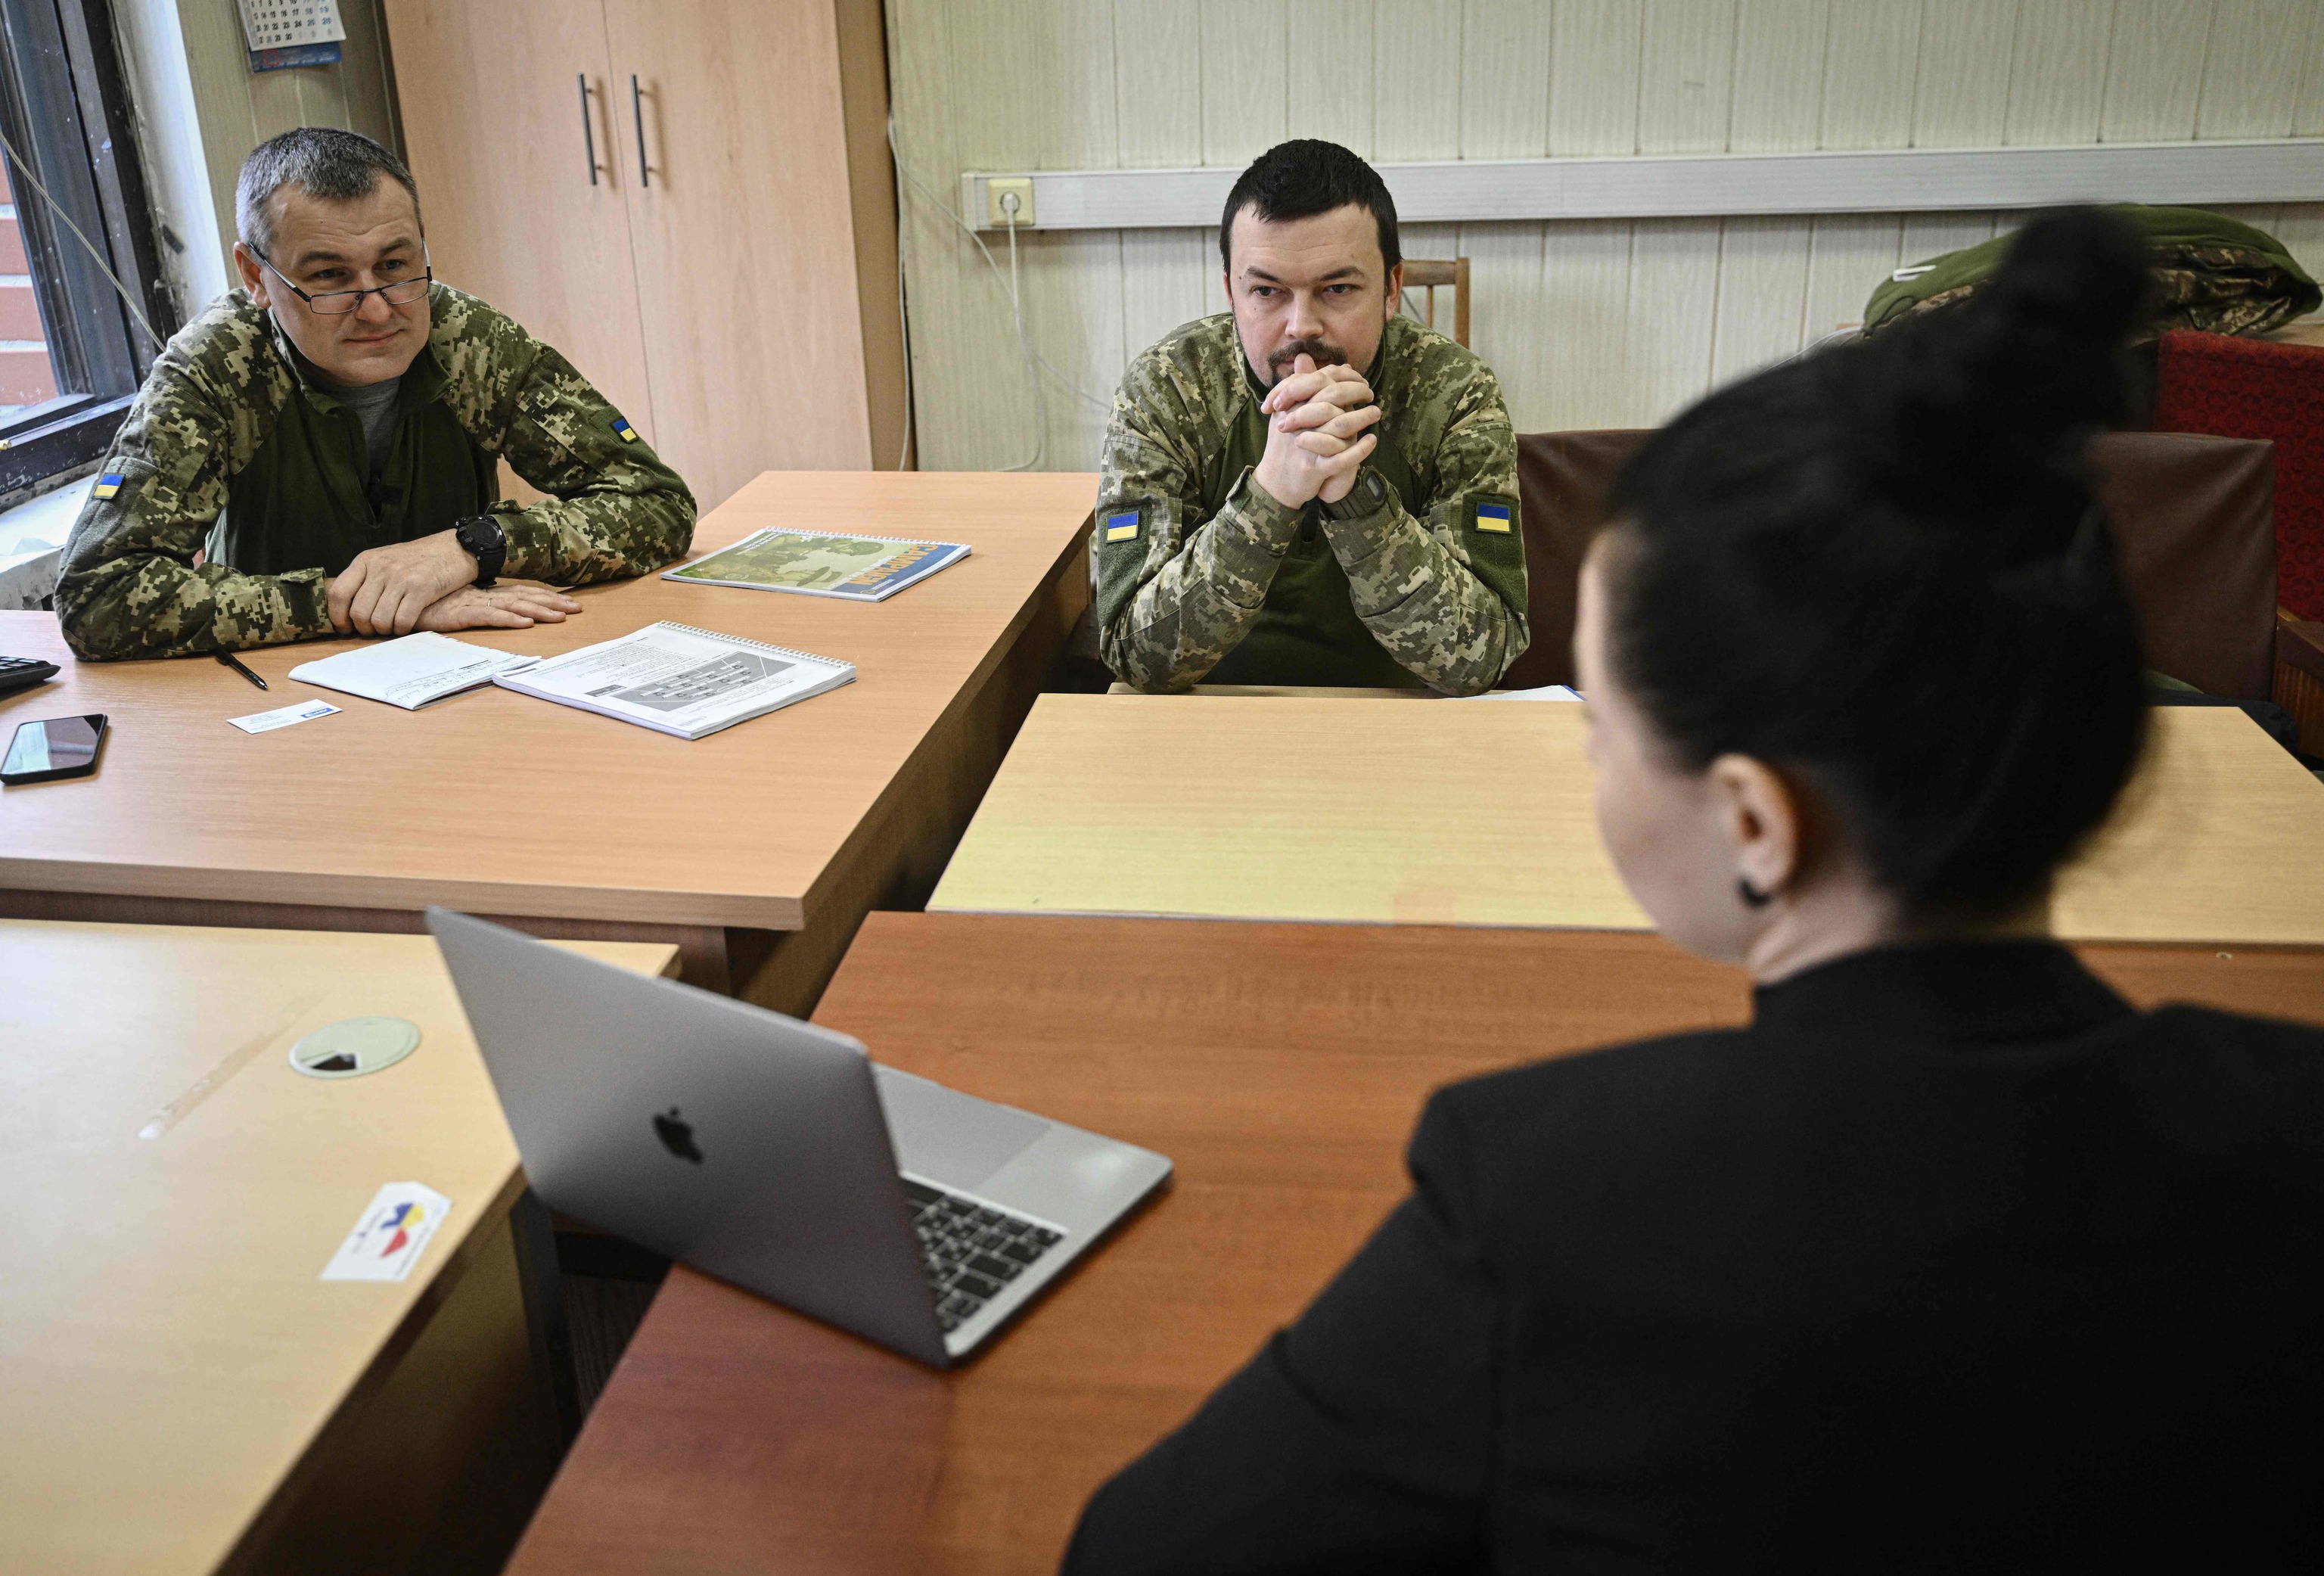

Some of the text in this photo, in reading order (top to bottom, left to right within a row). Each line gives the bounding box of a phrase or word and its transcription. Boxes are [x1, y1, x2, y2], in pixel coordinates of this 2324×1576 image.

[294, 20, 302, 28] 24
[307, 18, 315, 26] 25
[285, 33, 292, 41] 30
[847, 544, 939, 586] CAMPAIGN
